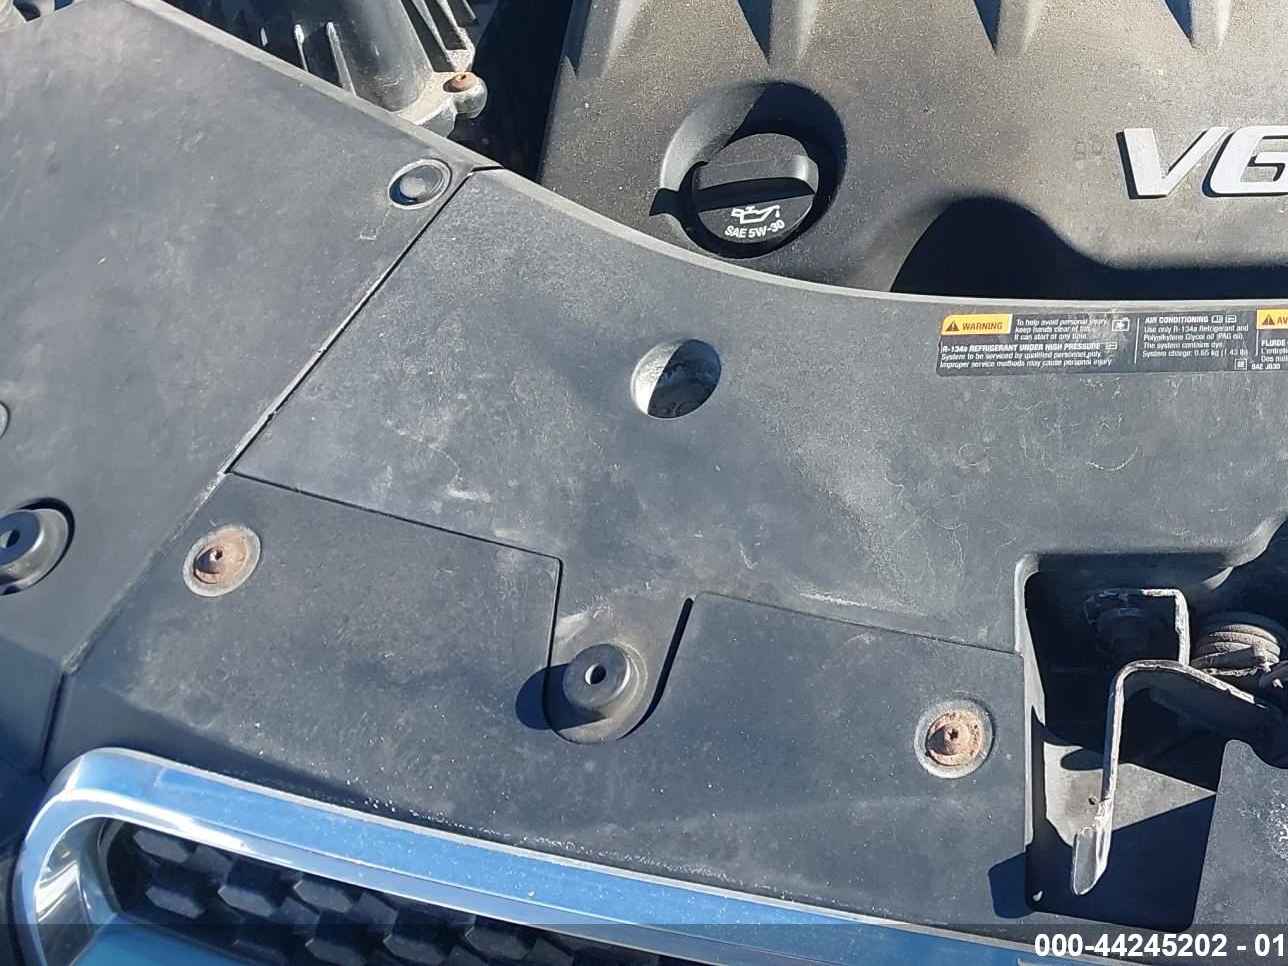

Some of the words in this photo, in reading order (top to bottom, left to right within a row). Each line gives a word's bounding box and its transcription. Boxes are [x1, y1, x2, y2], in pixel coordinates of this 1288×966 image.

[725, 225, 747, 238] SAE
[748, 219, 785, 237] 5W-30
[1059, 319, 1088, 327] personal
[1145, 316, 1157, 324] AIR
[1158, 315, 1209, 323] CONDITIONING
[962, 322, 1003, 331] WARNING
[1015, 326, 1031, 334] keep
[1157, 325, 1172, 334] only
[1173, 325, 1198, 333] R-134a
[1199, 324, 1236, 333] Refrigerant
[1236, 324, 1249, 332] and
[1185, 333, 1206, 342] Glycol
[1216, 332, 1232, 340] (PAG
[1143, 341, 1156, 349] The
[1156, 342, 1181, 350] system
[1181, 341, 1210, 349] contains
[1260, 338, 1286, 347] FLUIDE
[942, 345, 968, 353] R-134a
[969, 344, 1018, 352] REFRIGERANT
[1019, 343, 1044, 351] UNDER
[1064, 342, 1101, 350] PRESSURE
[941, 353, 966, 361] System
[1014, 352, 1023, 360] by
[1024, 351, 1053, 359] qualified
[1053, 351, 1086, 359] personnel
[1142, 350, 1167, 359] System
[1210, 348, 1220, 357] kg
[1261, 354, 1274, 362] Des
[940, 361, 970, 369] Improper
[1063, 359, 1092, 367] personal
